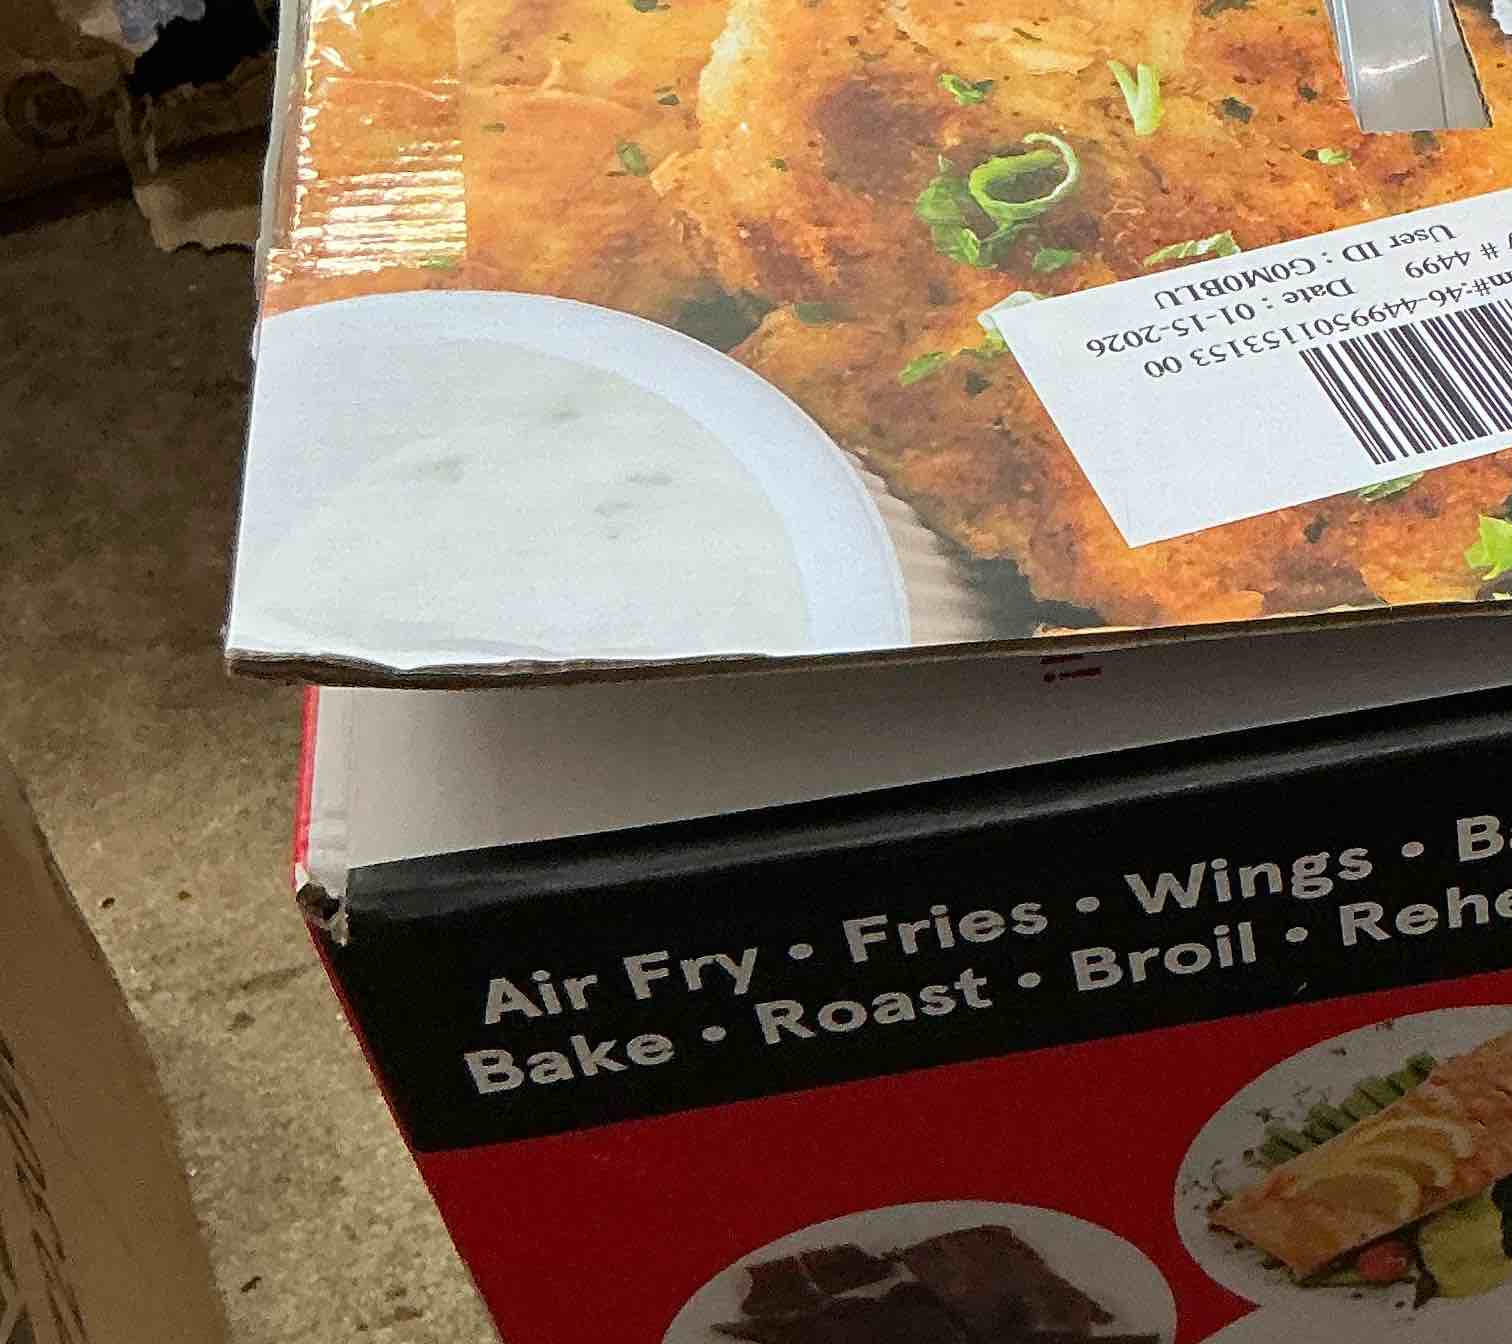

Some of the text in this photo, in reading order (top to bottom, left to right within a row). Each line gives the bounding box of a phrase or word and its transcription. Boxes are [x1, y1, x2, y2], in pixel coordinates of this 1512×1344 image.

[1389, 224, 1456, 249] User
[1342, 240, 1383, 262] ID
[1405, 251, 1470, 279] 4499
[1282, 278, 1355, 304] Date
[1086, 303, 1255, 357] 01-15-2026
[1144, 356, 1182, 378] 00
[485, 970, 597, 1024] Air
[623, 948, 757, 1000] Fry
[843, 903, 1047, 962] Fries
[1127, 848, 1371, 913] Wings
[465, 1034, 673, 1093] Bake
[756, 969, 990, 1044] Roast
[1072, 922, 1256, 991] Broil
